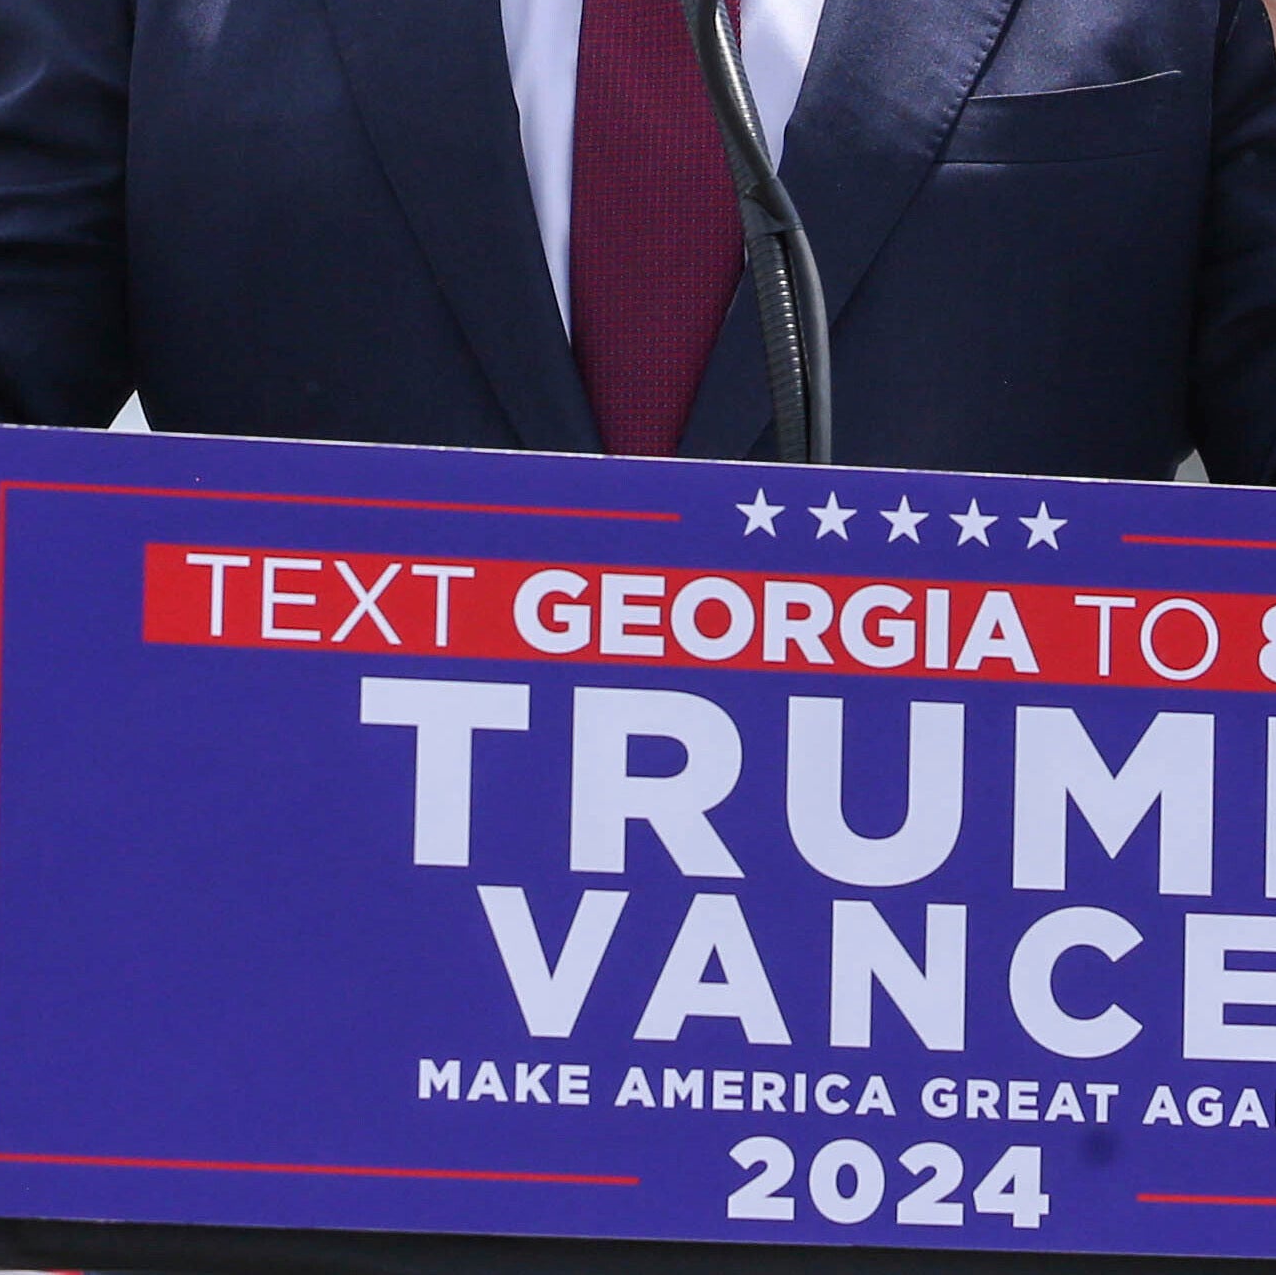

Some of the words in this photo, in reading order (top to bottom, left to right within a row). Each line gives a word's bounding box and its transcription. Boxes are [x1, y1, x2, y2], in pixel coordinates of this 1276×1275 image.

[186, 553, 475, 647] TEXT
[513, 569, 1040, 673] GEORGIA
[1074, 594, 1219, 681] TO
[418, 1058, 590, 1105] MAKE
[614, 1066, 896, 1116] AMERICA
[921, 1077, 1119, 1123] GREAT
[727, 1136, 1050, 1229] 2024
